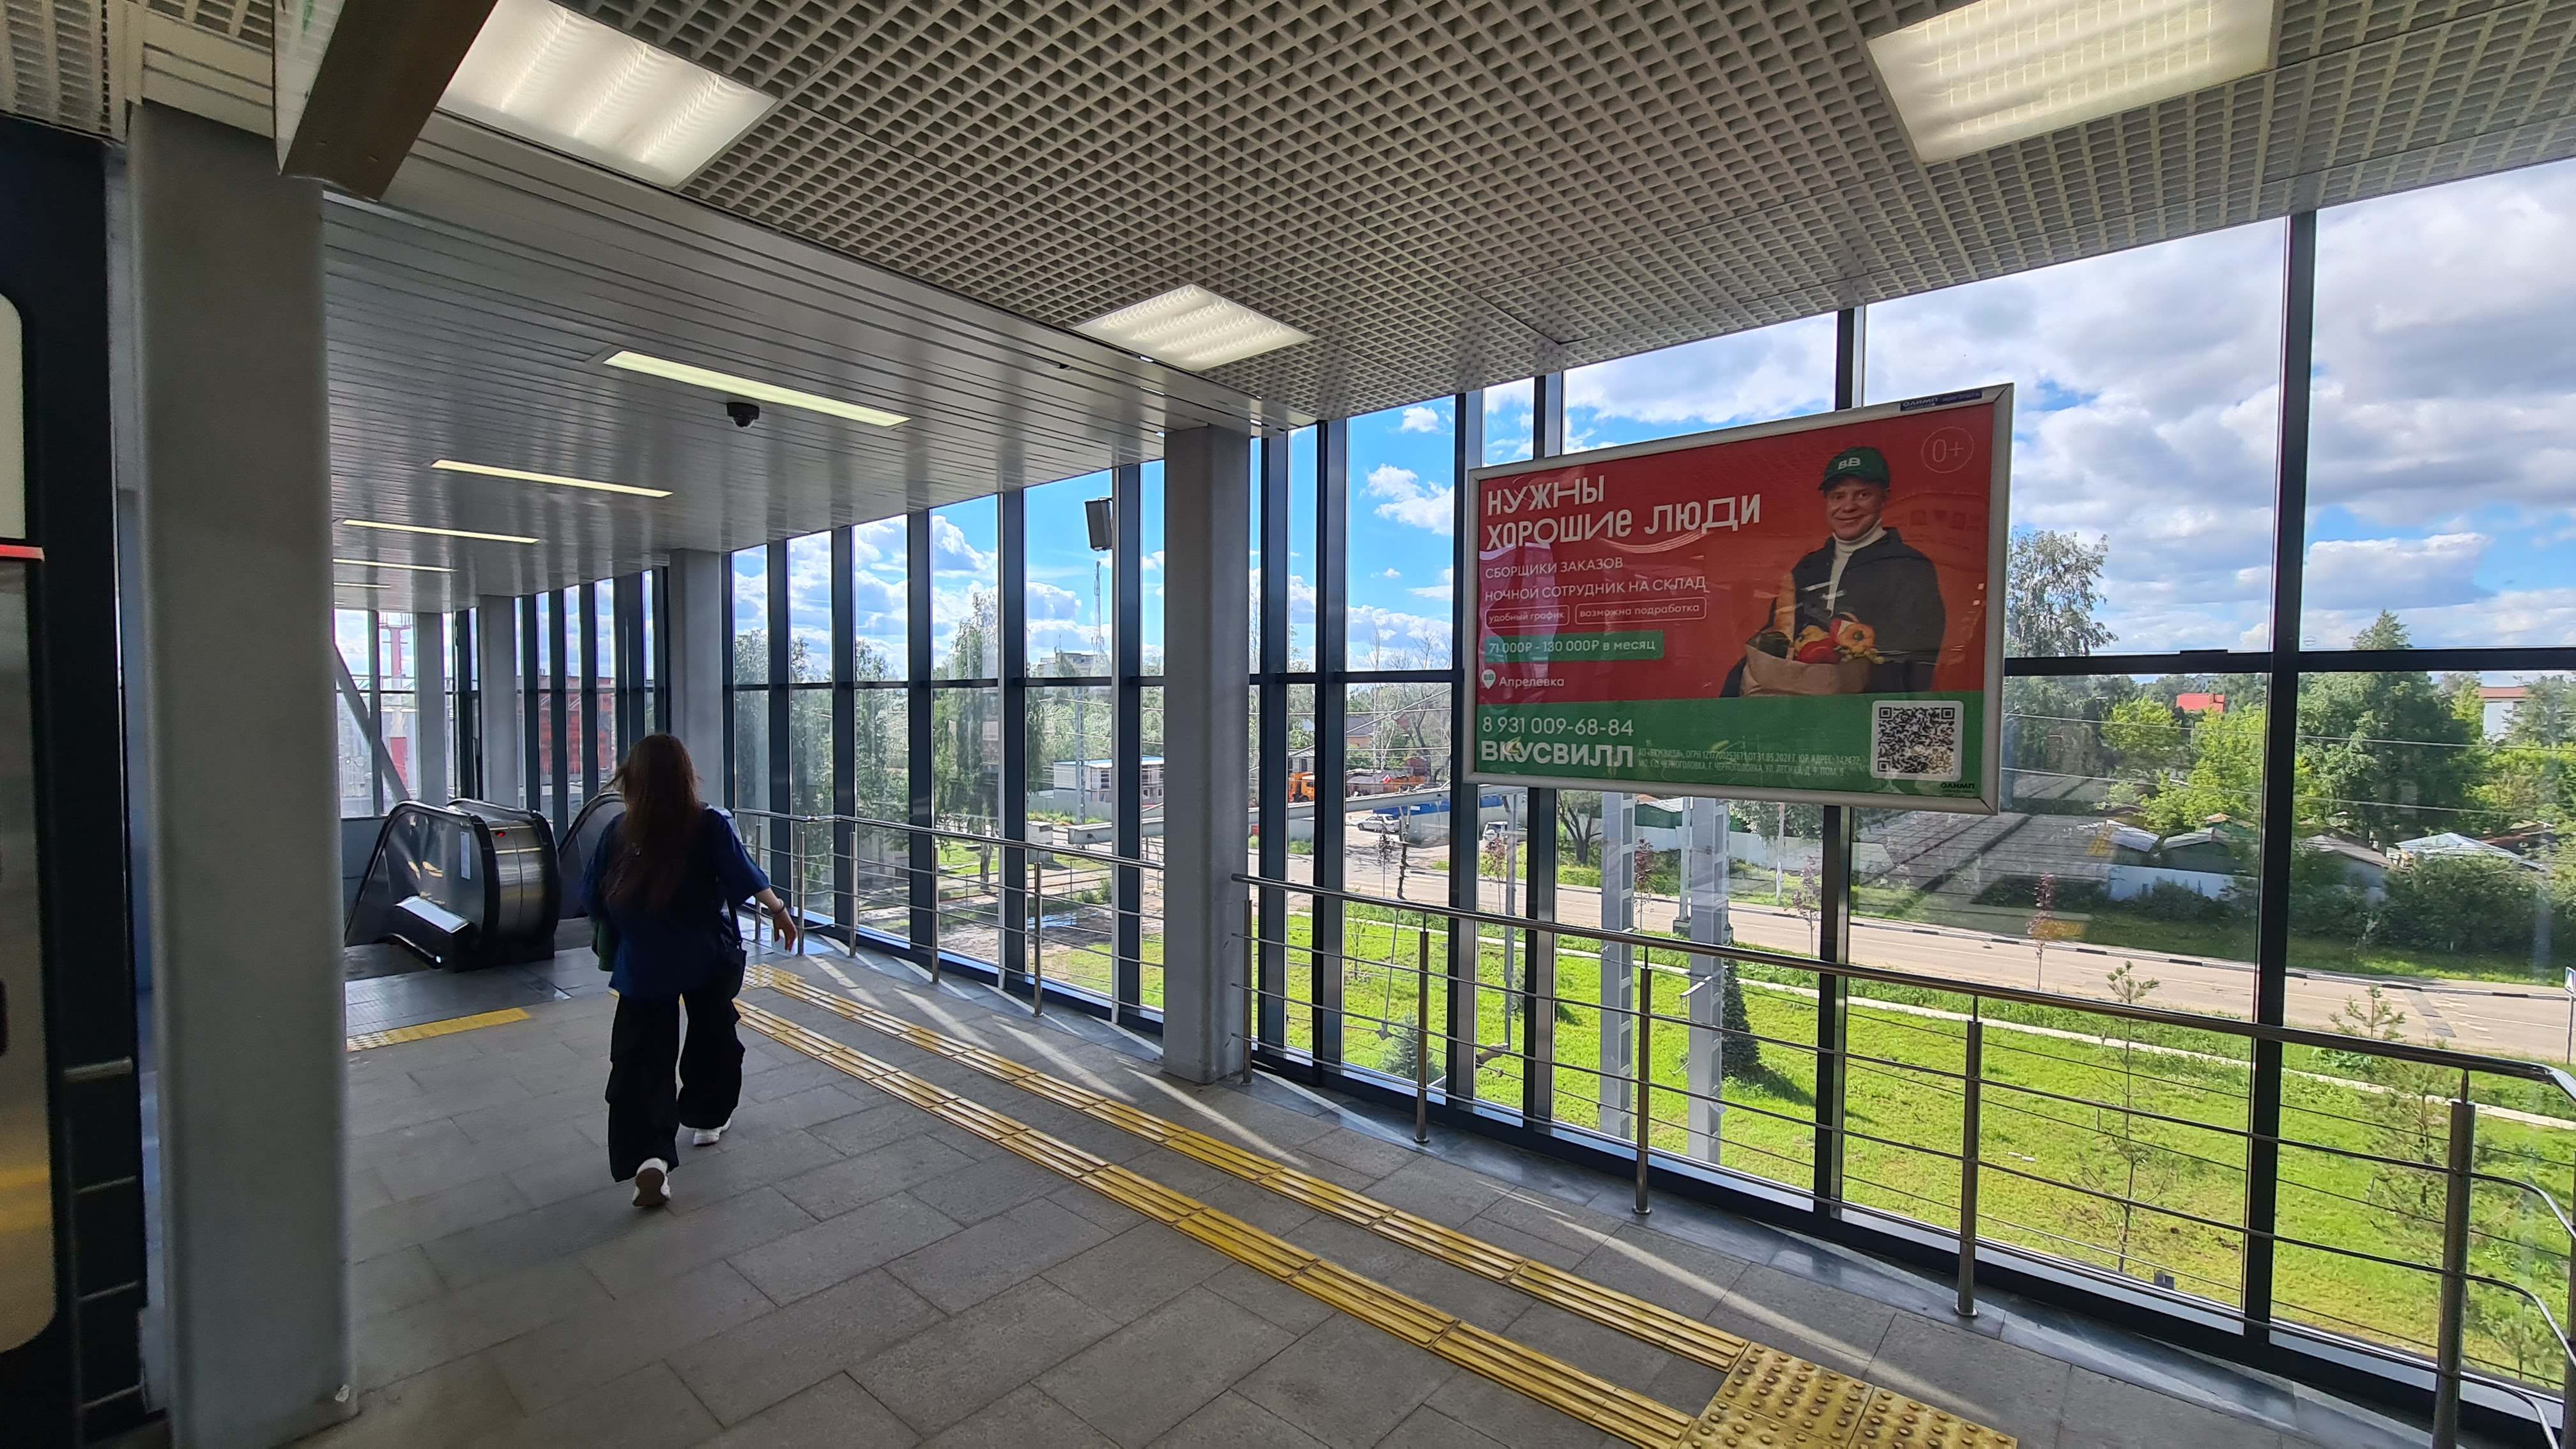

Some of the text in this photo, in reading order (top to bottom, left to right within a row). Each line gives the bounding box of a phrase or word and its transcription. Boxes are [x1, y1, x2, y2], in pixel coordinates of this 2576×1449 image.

[1933, 439, 1965, 463] 0+
[1487, 475, 1605, 517] НУЖНЫ
[1644, 493, 1761, 535] ЛЮДИ
[1485, 556, 1623, 579] СБОРЩИКИ ЗАКАЗОВ
[1485, 576, 1708, 602] НОЧНОЙ СОТРУДНИК НА СКЛАД
[1489, 610, 1565, 624] удобный график
[1579, 604, 1700, 618] возможна подработка
[1488, 642, 1499, 654] 71
[1543, 641, 1563, 652] 130
[1602, 642, 1609, 651] в
[1613, 640, 1656, 652] месяц
[1499, 676, 1565, 689] Апрелевка
[1482, 716, 1634, 736] 8 931 009-68-84
[1481, 740, 1634, 767] ВКУСВИЛЛ
